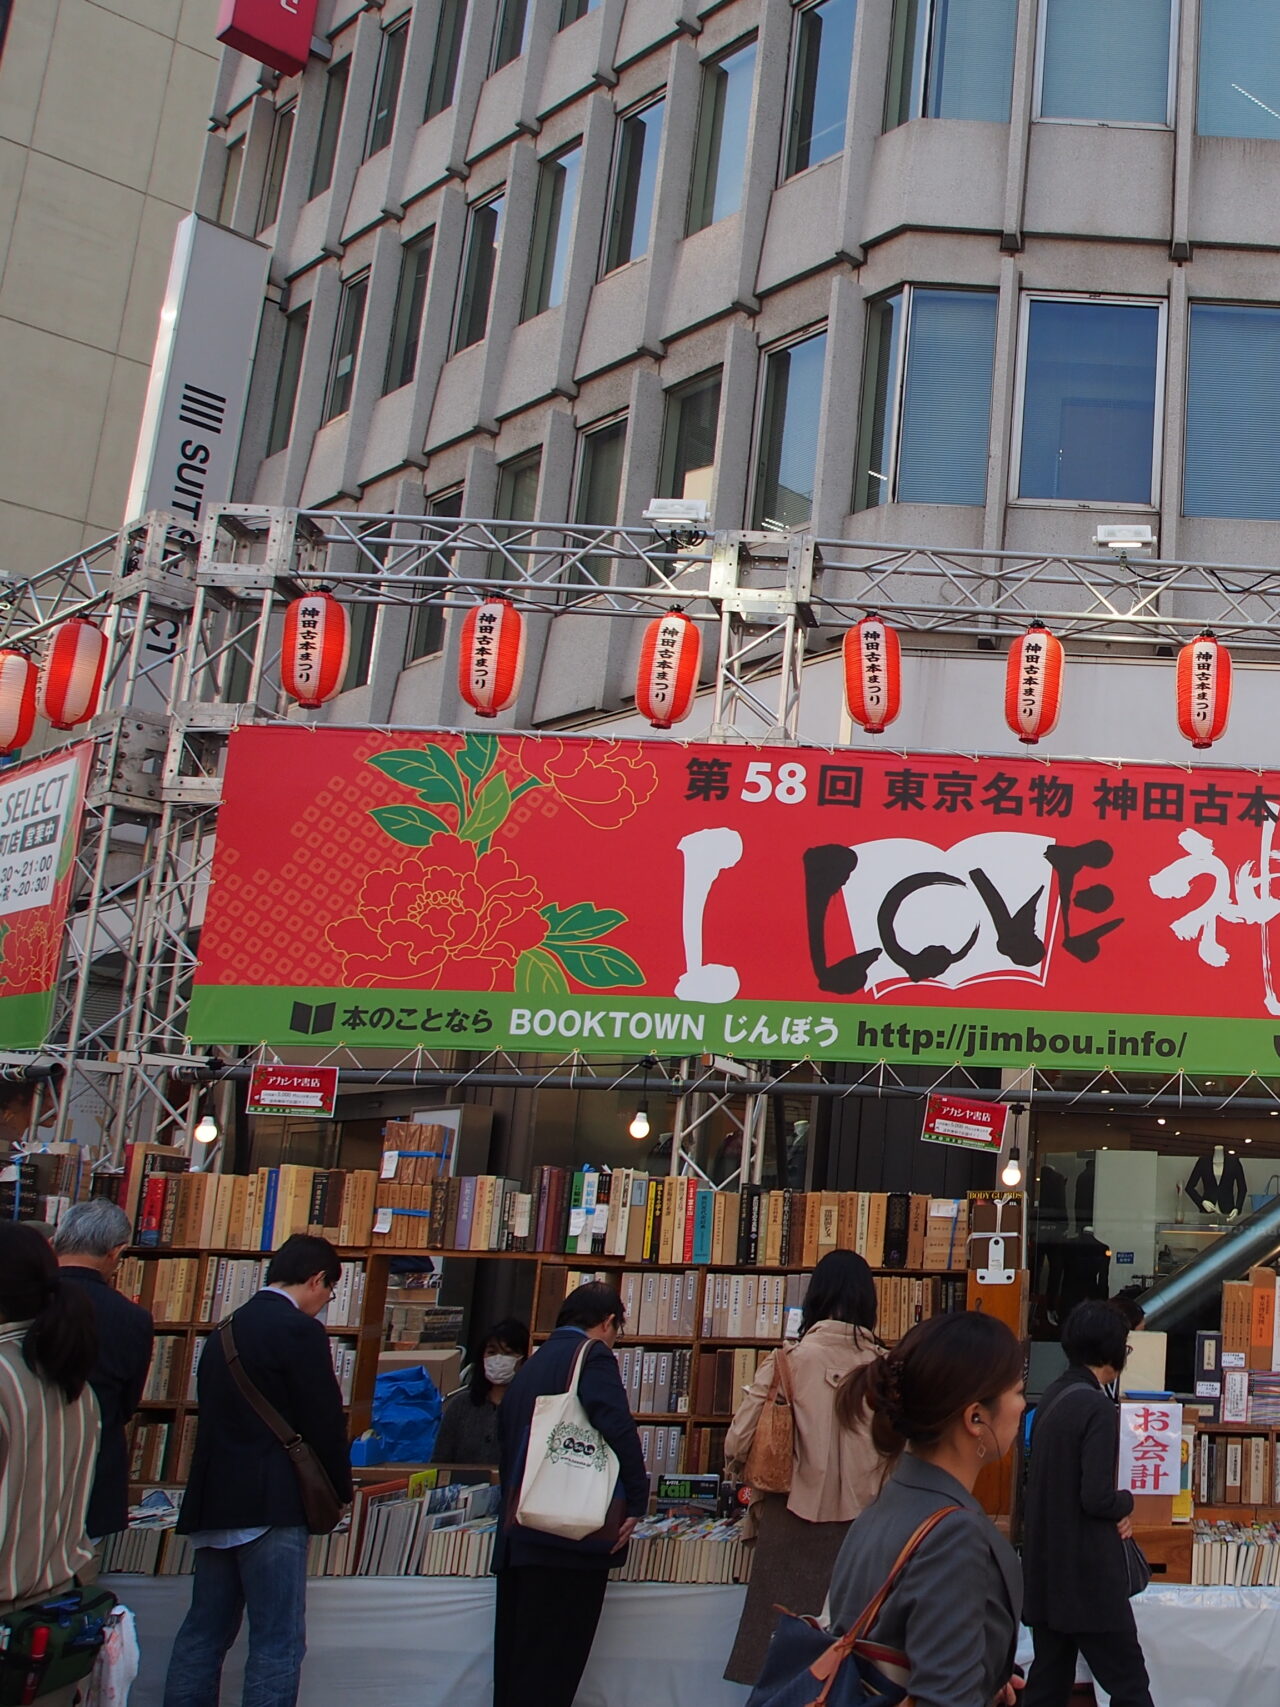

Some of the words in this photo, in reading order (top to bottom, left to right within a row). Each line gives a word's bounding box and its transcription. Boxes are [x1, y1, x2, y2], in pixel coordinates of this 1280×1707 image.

[171, 440, 210, 522] SUIT
[298, 607, 320, 684] 神田古本まつり
[474, 612, 498, 690] 神田古本まつり
[654, 626, 681, 703] 神田古本まつり
[862, 630, 883, 706] 神田古本まつり
[1021, 642, 1043, 719] 神田古本まつり
[1193, 650, 1213, 722] 神田古本まつり
[1, 773, 69, 828] SELECT
[684, 757, 865, 808] 第58回
[883, 768, 1074, 819] 東京名物
[674, 827, 744, 1004] I
[802, 839, 1126, 995] LOVE
[341, 1006, 494, 1033] 本のことなら
[509, 1008, 706, 1041] BOOKTOWN
[722, 1014, 840, 1047] じんぼう
[856, 1020, 1188, 1059] http://jimbou.info/
[1130, 1407, 1170, 1490] お会計
